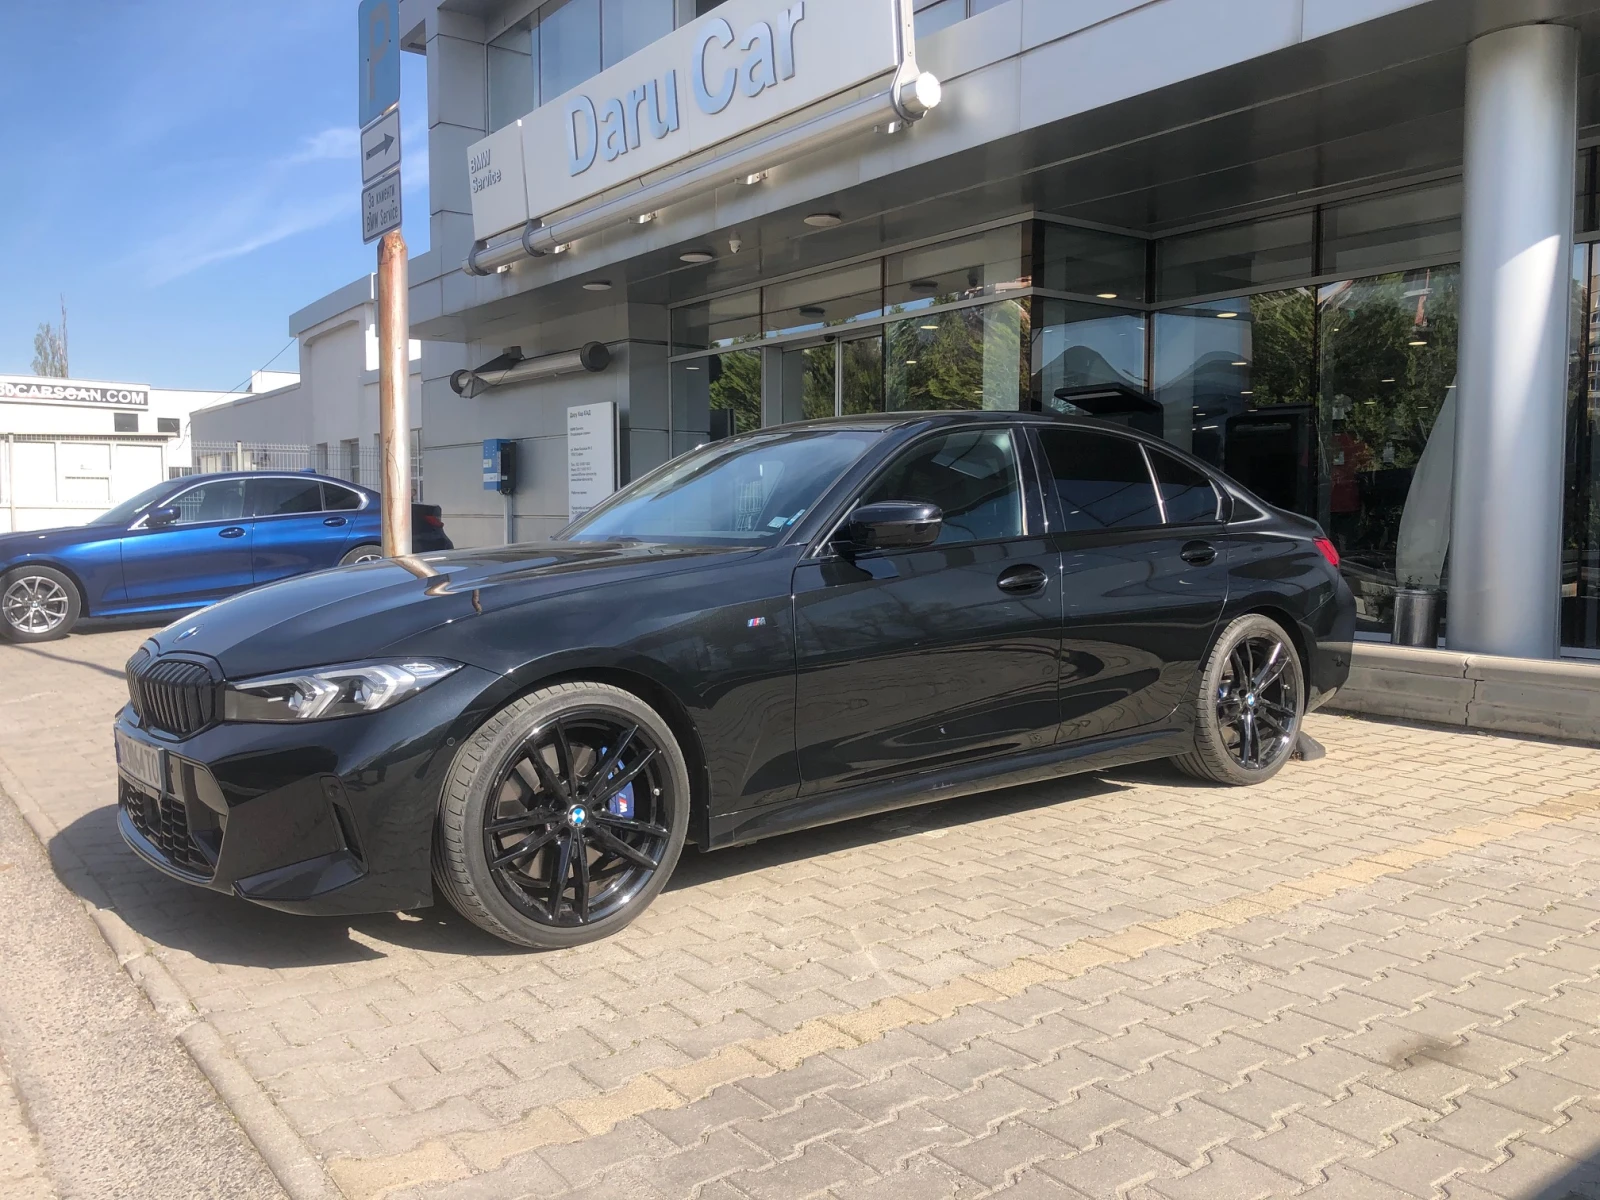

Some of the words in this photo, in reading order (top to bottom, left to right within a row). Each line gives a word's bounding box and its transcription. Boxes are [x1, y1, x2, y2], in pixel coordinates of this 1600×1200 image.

[565, 68, 680, 176] Daru
[692, 1, 805, 115] Car
[470, 148, 491, 174] BMW
[472, 169, 502, 194] Service
[367, 192, 375, 209] За
[367, 212, 379, 232] BMW
[380, 205, 399, 225] Service
